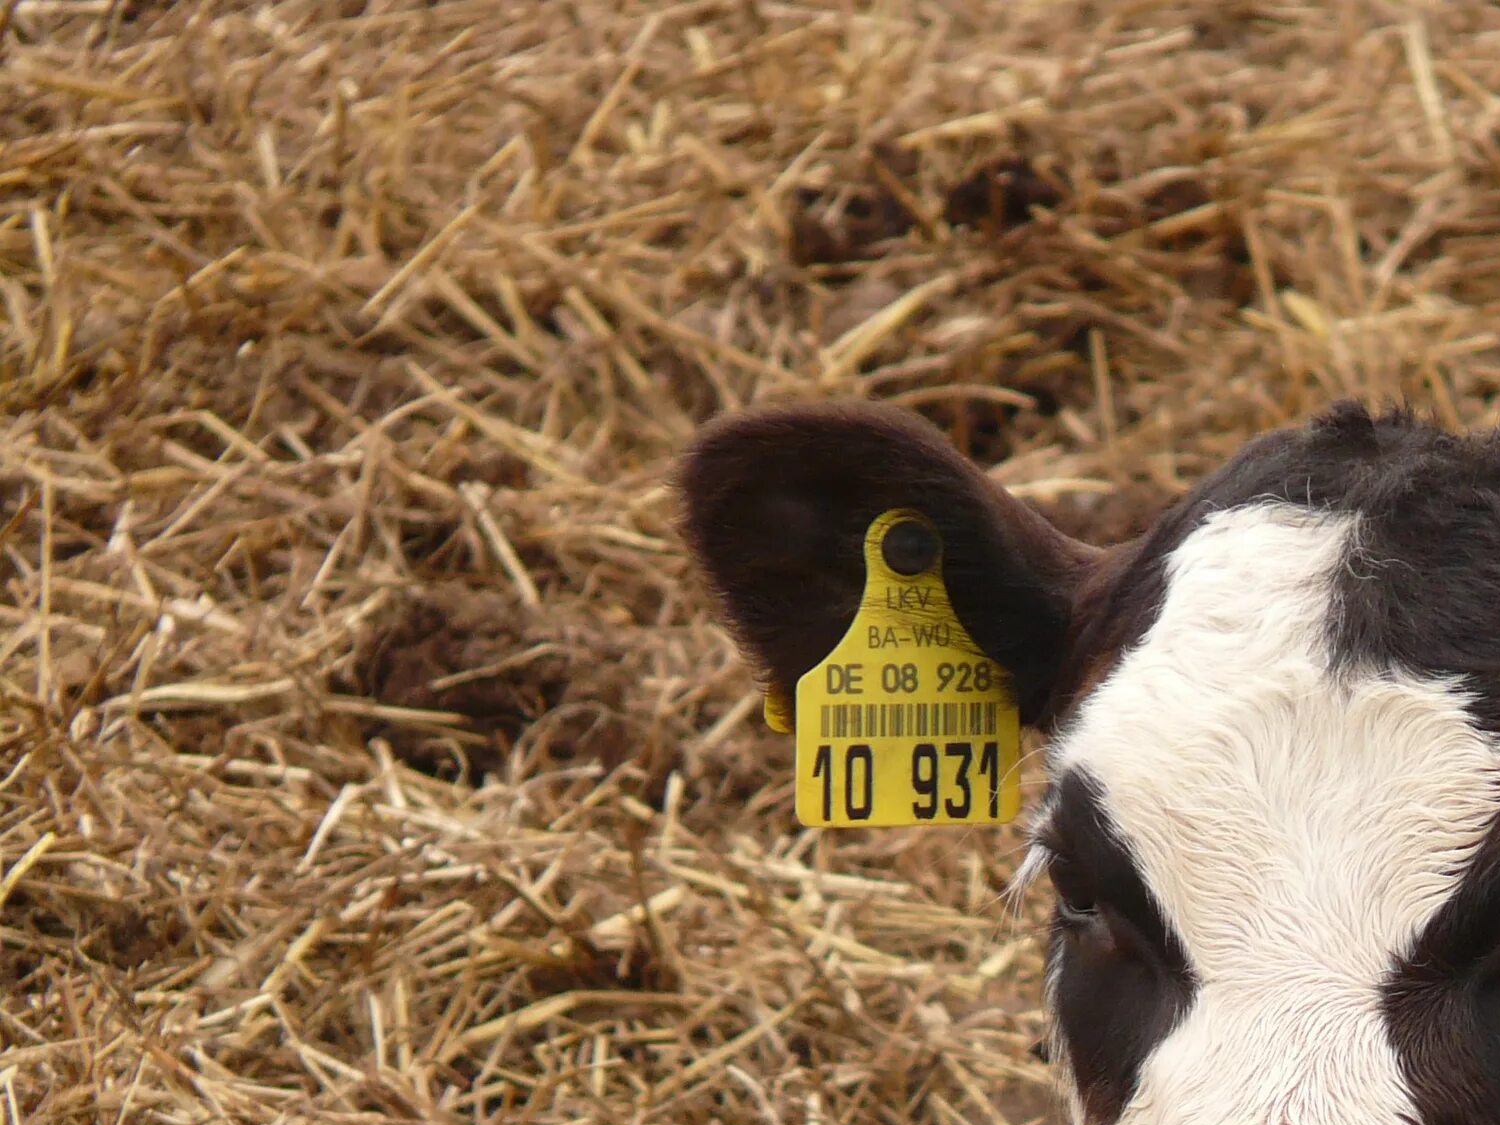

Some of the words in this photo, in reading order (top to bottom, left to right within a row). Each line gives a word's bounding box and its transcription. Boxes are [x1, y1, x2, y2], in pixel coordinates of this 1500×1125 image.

[826, 663, 863, 694] DE
[882, 663, 919, 693] 08
[937, 662, 993, 692] 928
[812, 744, 874, 821] 10
[911, 742, 999, 819] 931
